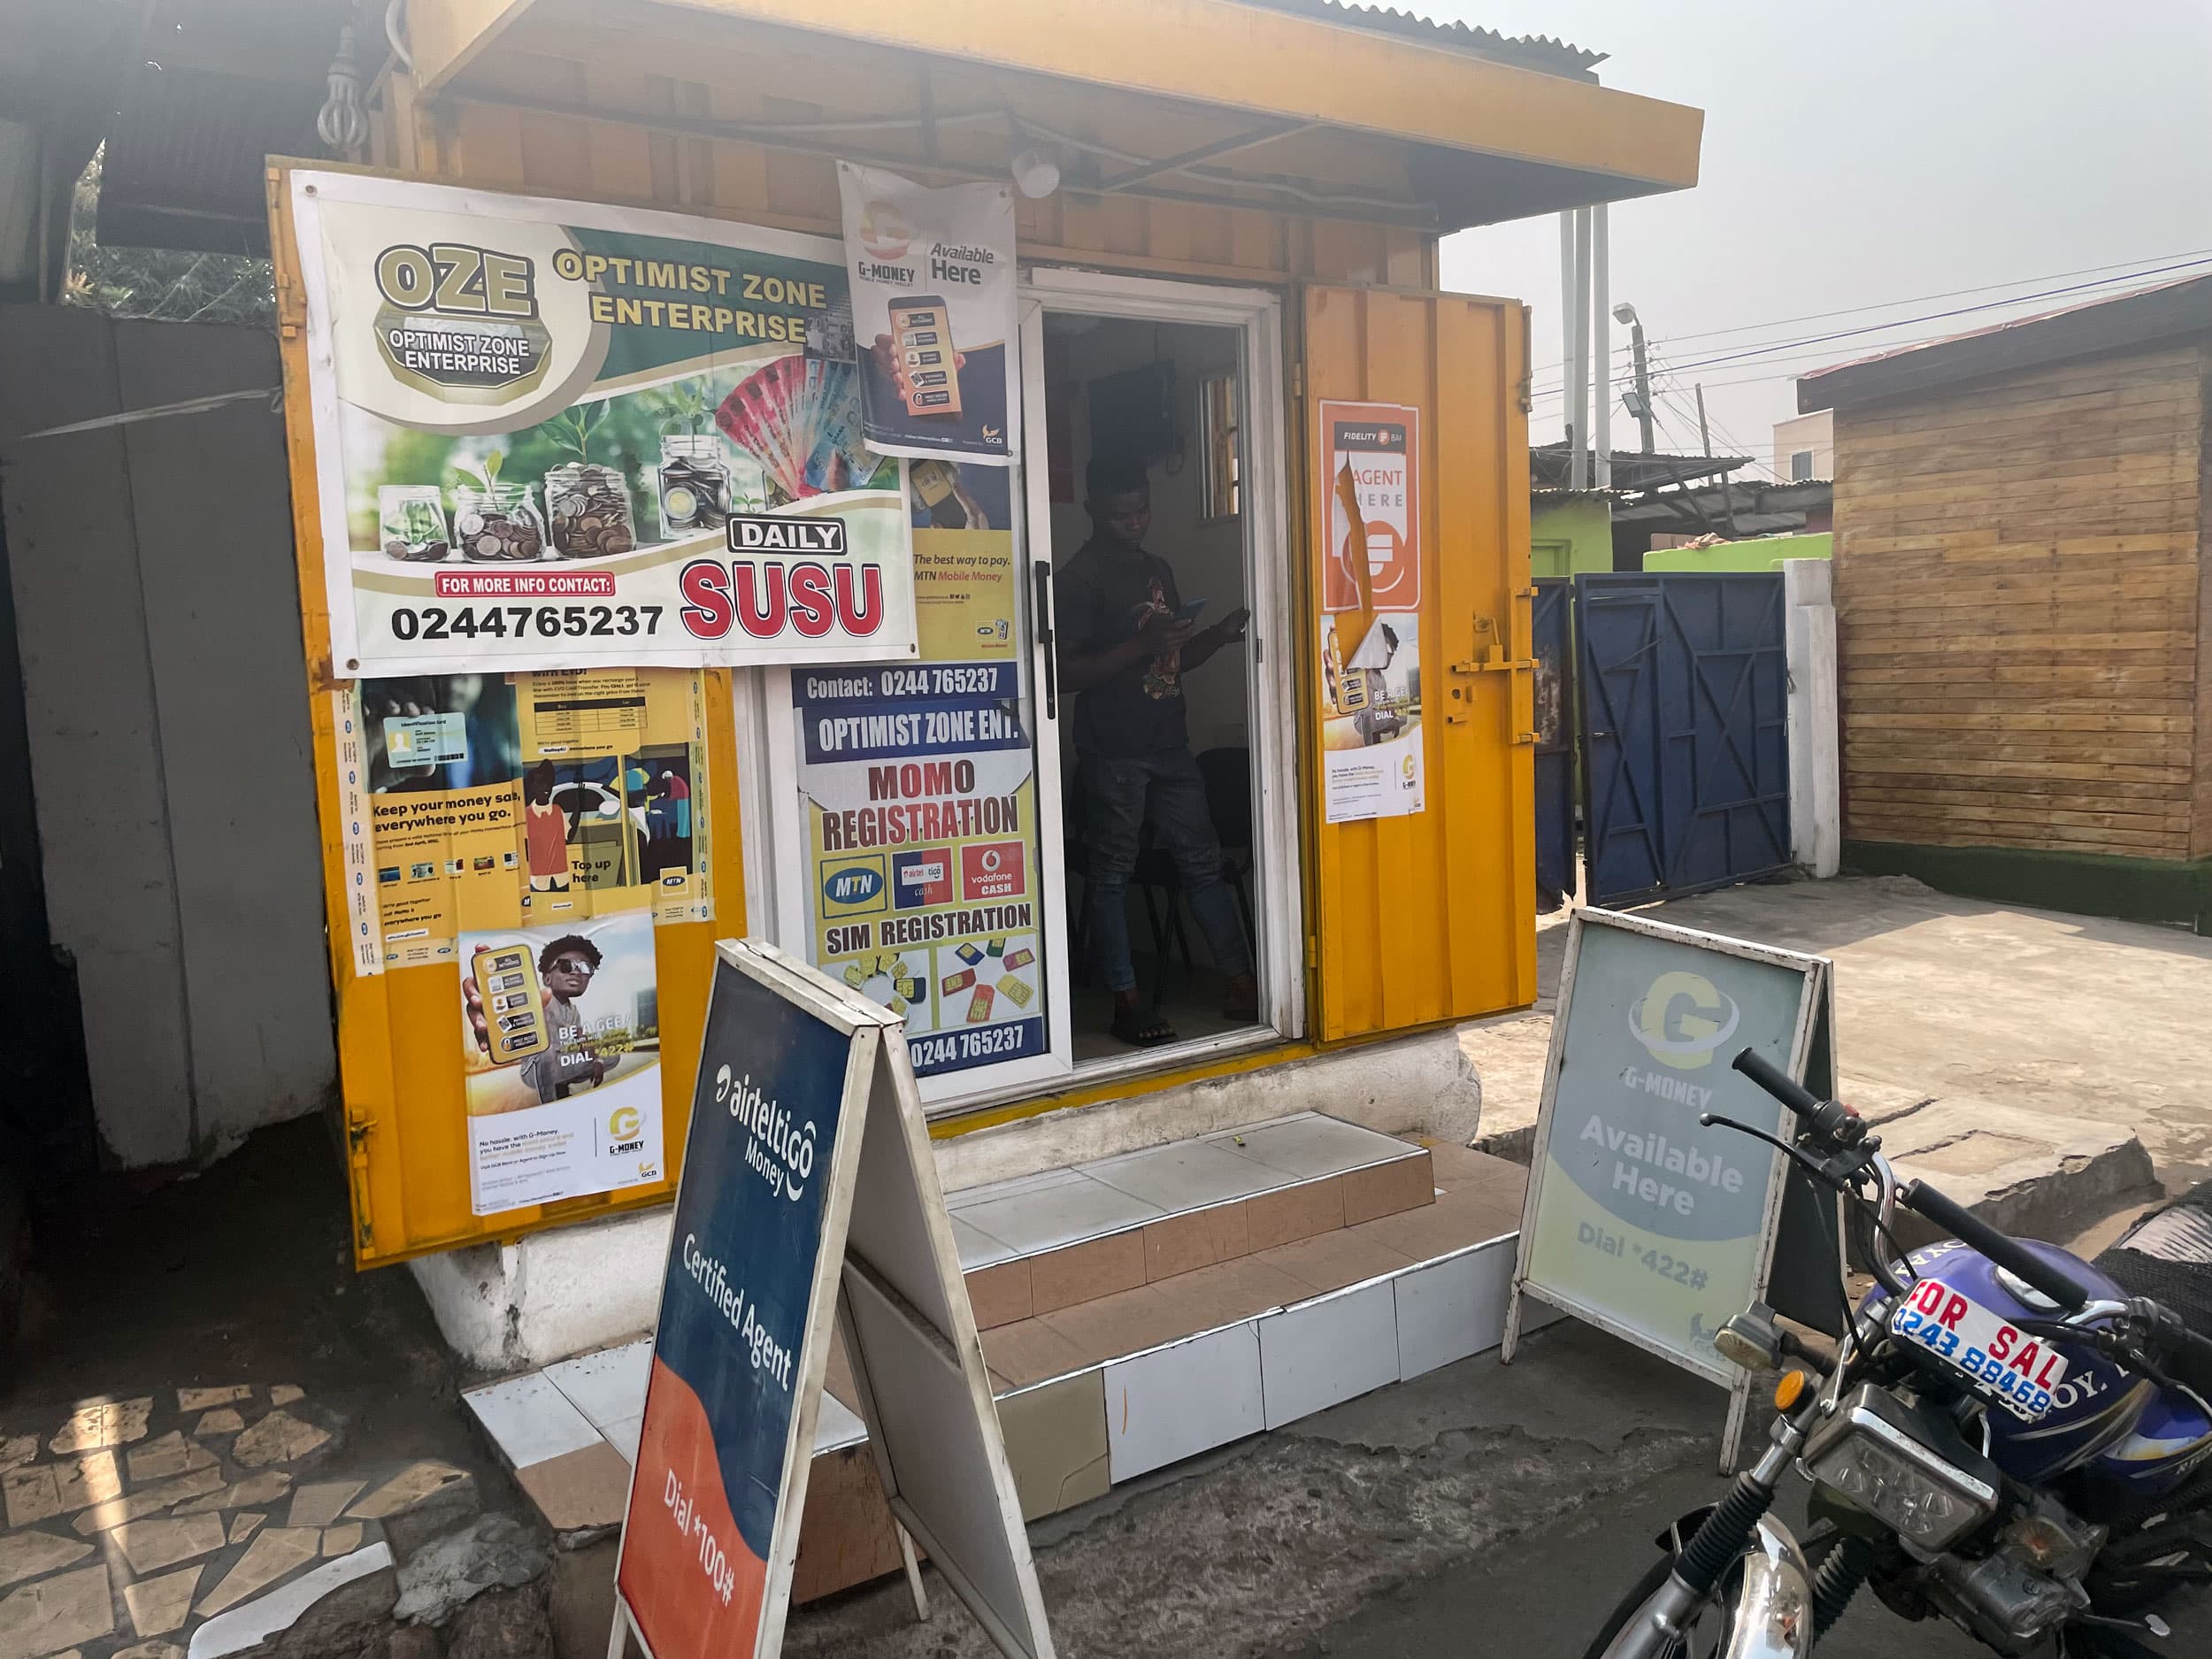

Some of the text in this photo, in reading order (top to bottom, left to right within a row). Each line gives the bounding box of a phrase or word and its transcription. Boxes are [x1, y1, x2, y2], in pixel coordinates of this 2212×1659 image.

[931, 242, 994, 264] Available
[375, 243, 539, 319] OZE
[553, 249, 827, 309] OPTIMIST ZONE
[858, 261, 915, 283] G-MONEY
[932, 258, 981, 286] Here
[589, 293, 808, 343] ENTERPRISE
[389, 329, 530, 357] OPTIMIST ZONE
[404, 350, 520, 375] ENTERPRISE
[1344, 432, 1377, 441] FIDELITY
[1354, 470, 1402, 485] AGENT
[741, 522, 838, 549] DAILY
[914, 554, 1010, 567] The best way to pay.
[442, 577, 611, 593] FOR MORE INFO CONTACT:
[914, 571, 1002, 583] MTN Mobile Money
[680, 559, 885, 640] SUSU
[392, 606, 664, 640] 0244765237
[807, 667, 998, 698] Contact: 0244 765237
[1374, 690, 1386, 701] BE
[1375, 710, 1394, 721] DIAL
[818, 714, 921, 751] OPTIMIST
[926, 710, 973, 744] ZONE
[868, 759, 975, 802] MOMO
[373, 804, 408, 818] Keep
[411, 801, 443, 815] your
[445, 797, 492, 811] money
[374, 809, 511, 833] everywhere you go.
[822, 795, 1018, 851] REGISTRATION
[571, 858, 611, 870] Top up
[572, 872, 599, 883] here
[835, 874, 872, 897] MTN
[972, 872, 1012, 884] vodafone
[914, 884, 1012, 896] cash CASH
[826, 903, 1032, 955] SIM REGISTRATION
[559, 1025, 578, 1040] BE
[910, 1025, 1024, 1068] 0244 765237
[560, 1050, 594, 1067] DIAL
[1624, 1066, 1714, 1110] G-MONEY
[730, 1073, 817, 1179] airteltigo
[610, 1141, 644, 1154] G-MONEY
[1580, 1115, 1744, 1194] Available
[745, 1136, 785, 1197] Money
[1612, 1161, 1695, 1217] Here
[1578, 1221, 1625, 1259] Dial
[684, 1233, 792, 1392] Certified Agent
[1903, 1281, 1969, 1332] FOR
[1988, 1325, 2061, 1390] SAL
[664, 1468, 694, 1537] Dial
